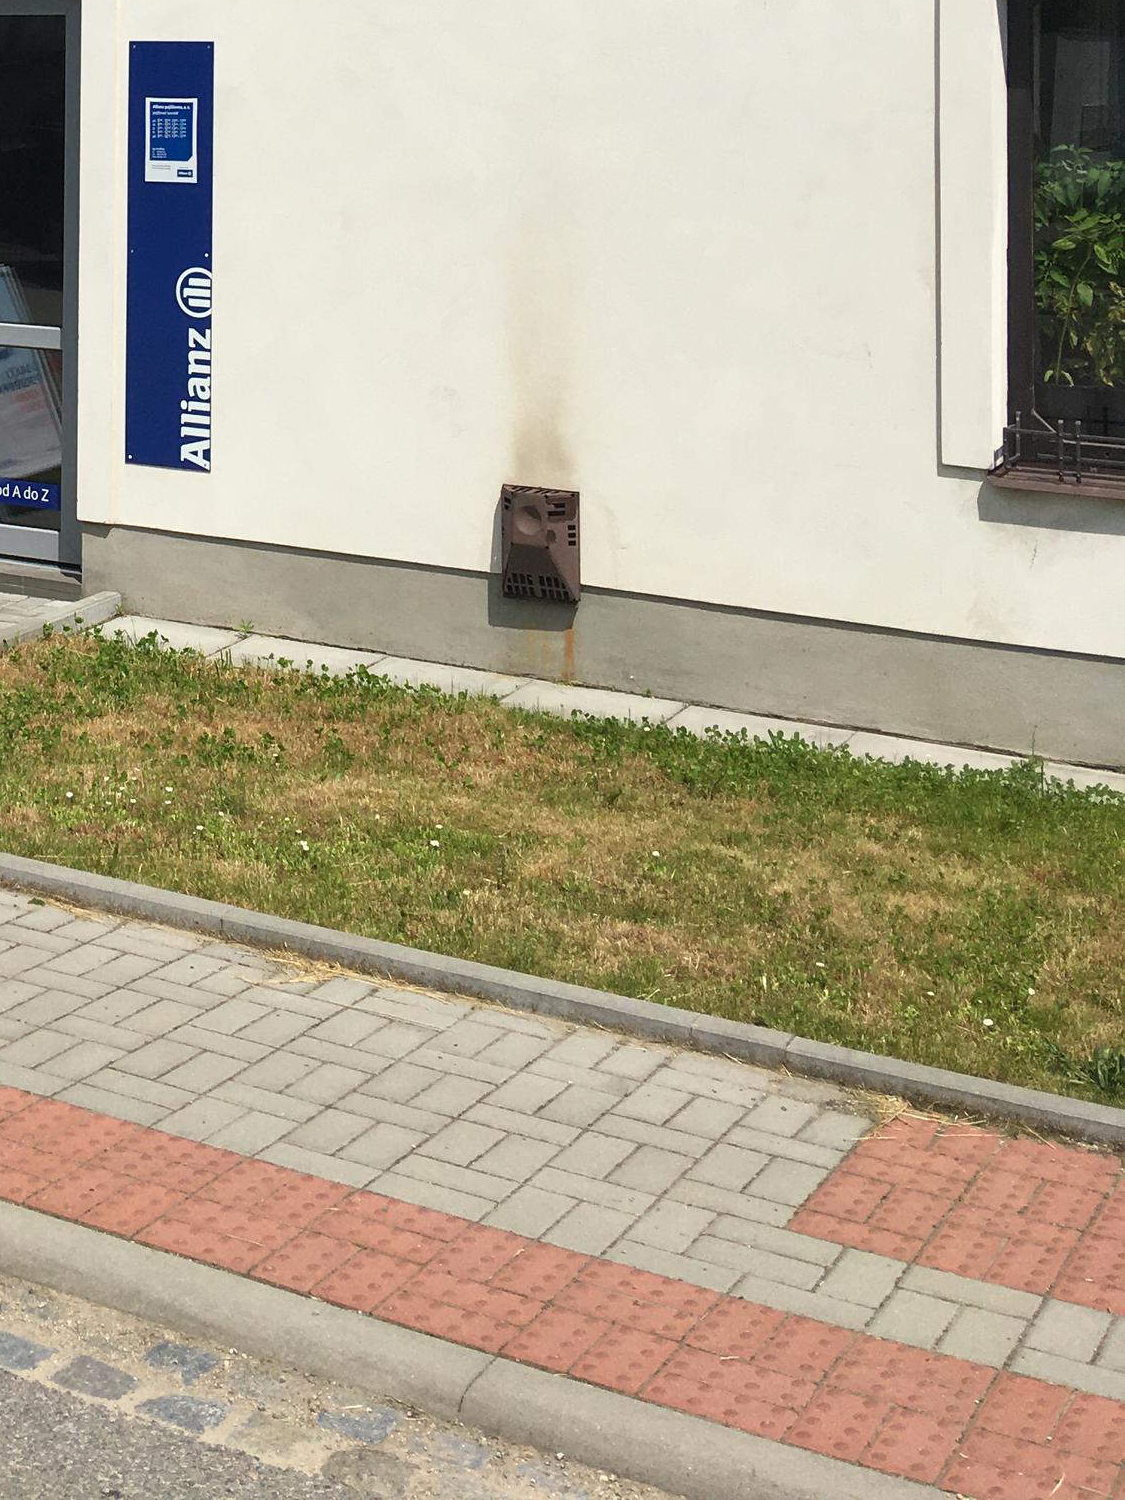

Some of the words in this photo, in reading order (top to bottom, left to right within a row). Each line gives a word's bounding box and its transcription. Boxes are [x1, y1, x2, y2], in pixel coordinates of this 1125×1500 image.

[180, 327, 211, 471] Allianz
[12, 485, 21, 498] A
[23, 486, 38, 501] do
[41, 489, 50, 502] Z
